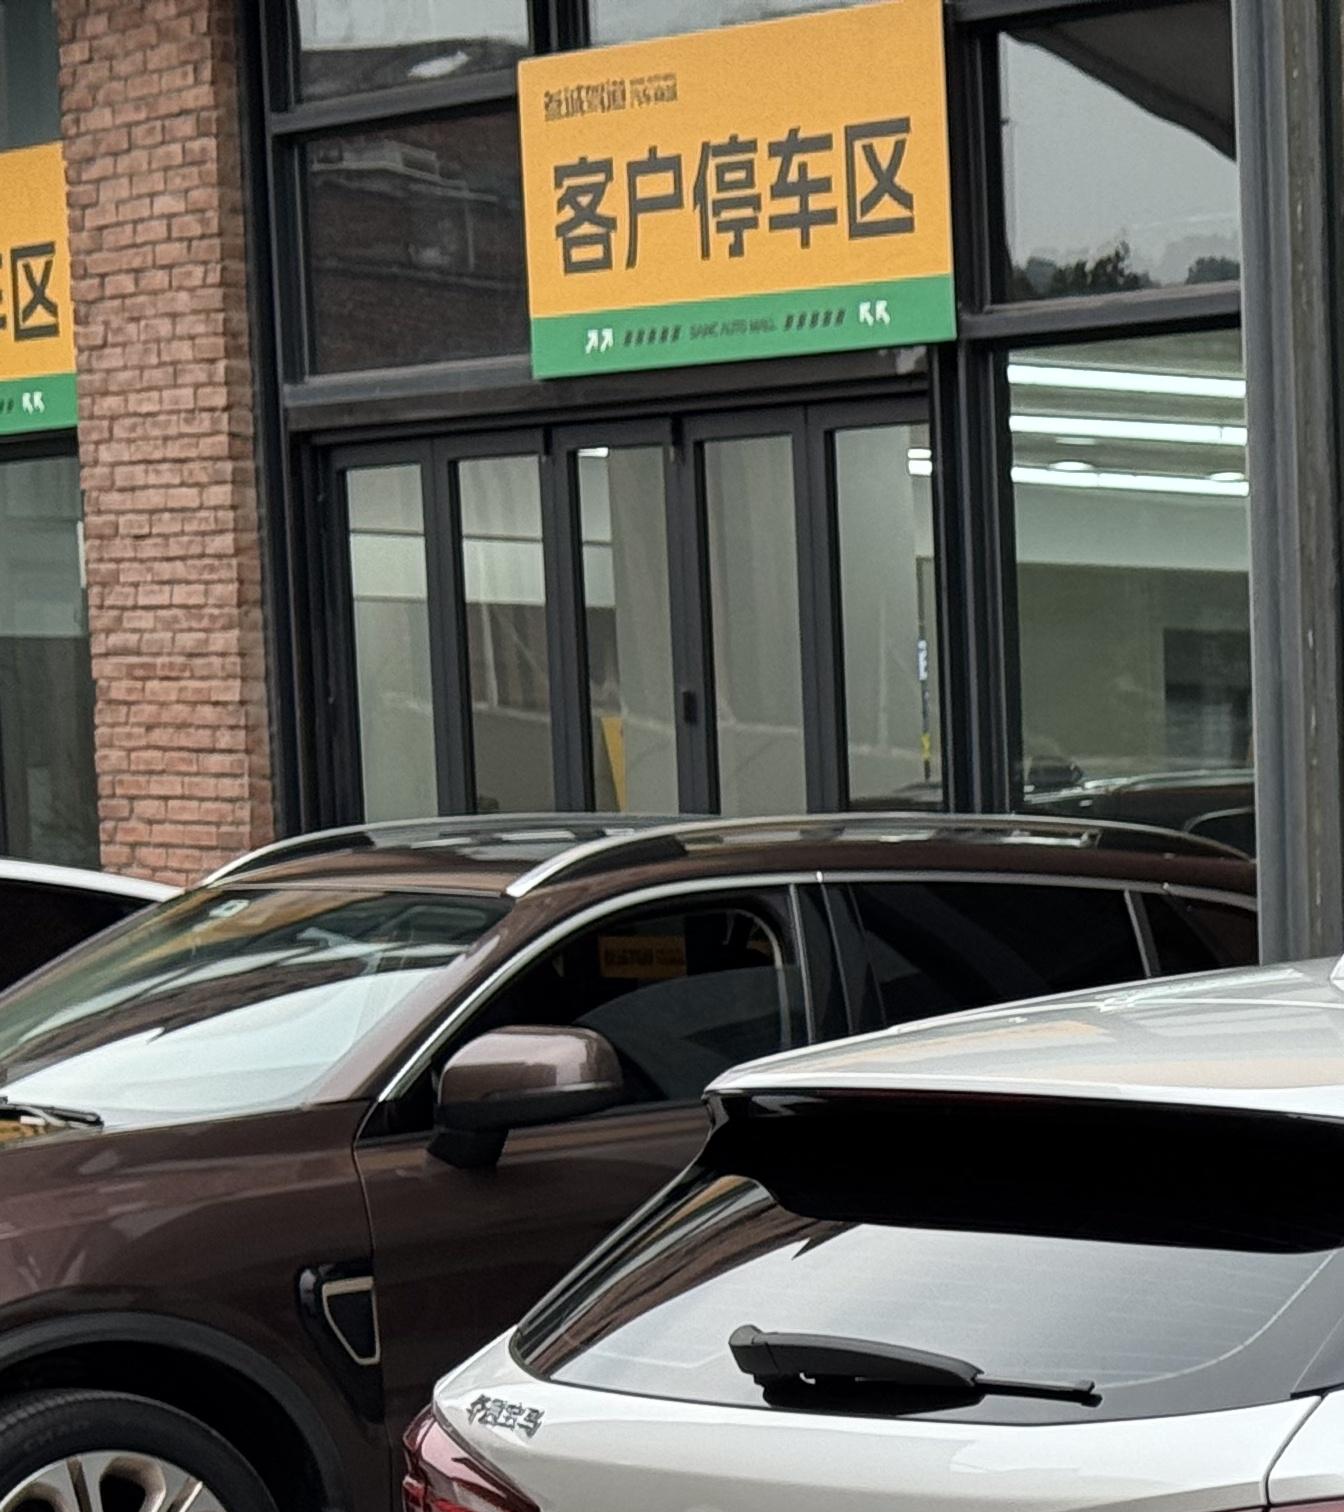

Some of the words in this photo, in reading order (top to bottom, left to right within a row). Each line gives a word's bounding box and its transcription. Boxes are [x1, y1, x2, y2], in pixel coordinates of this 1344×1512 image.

[554, 116, 915, 276] 客户停车区
[0, 241, 60, 342] 区
